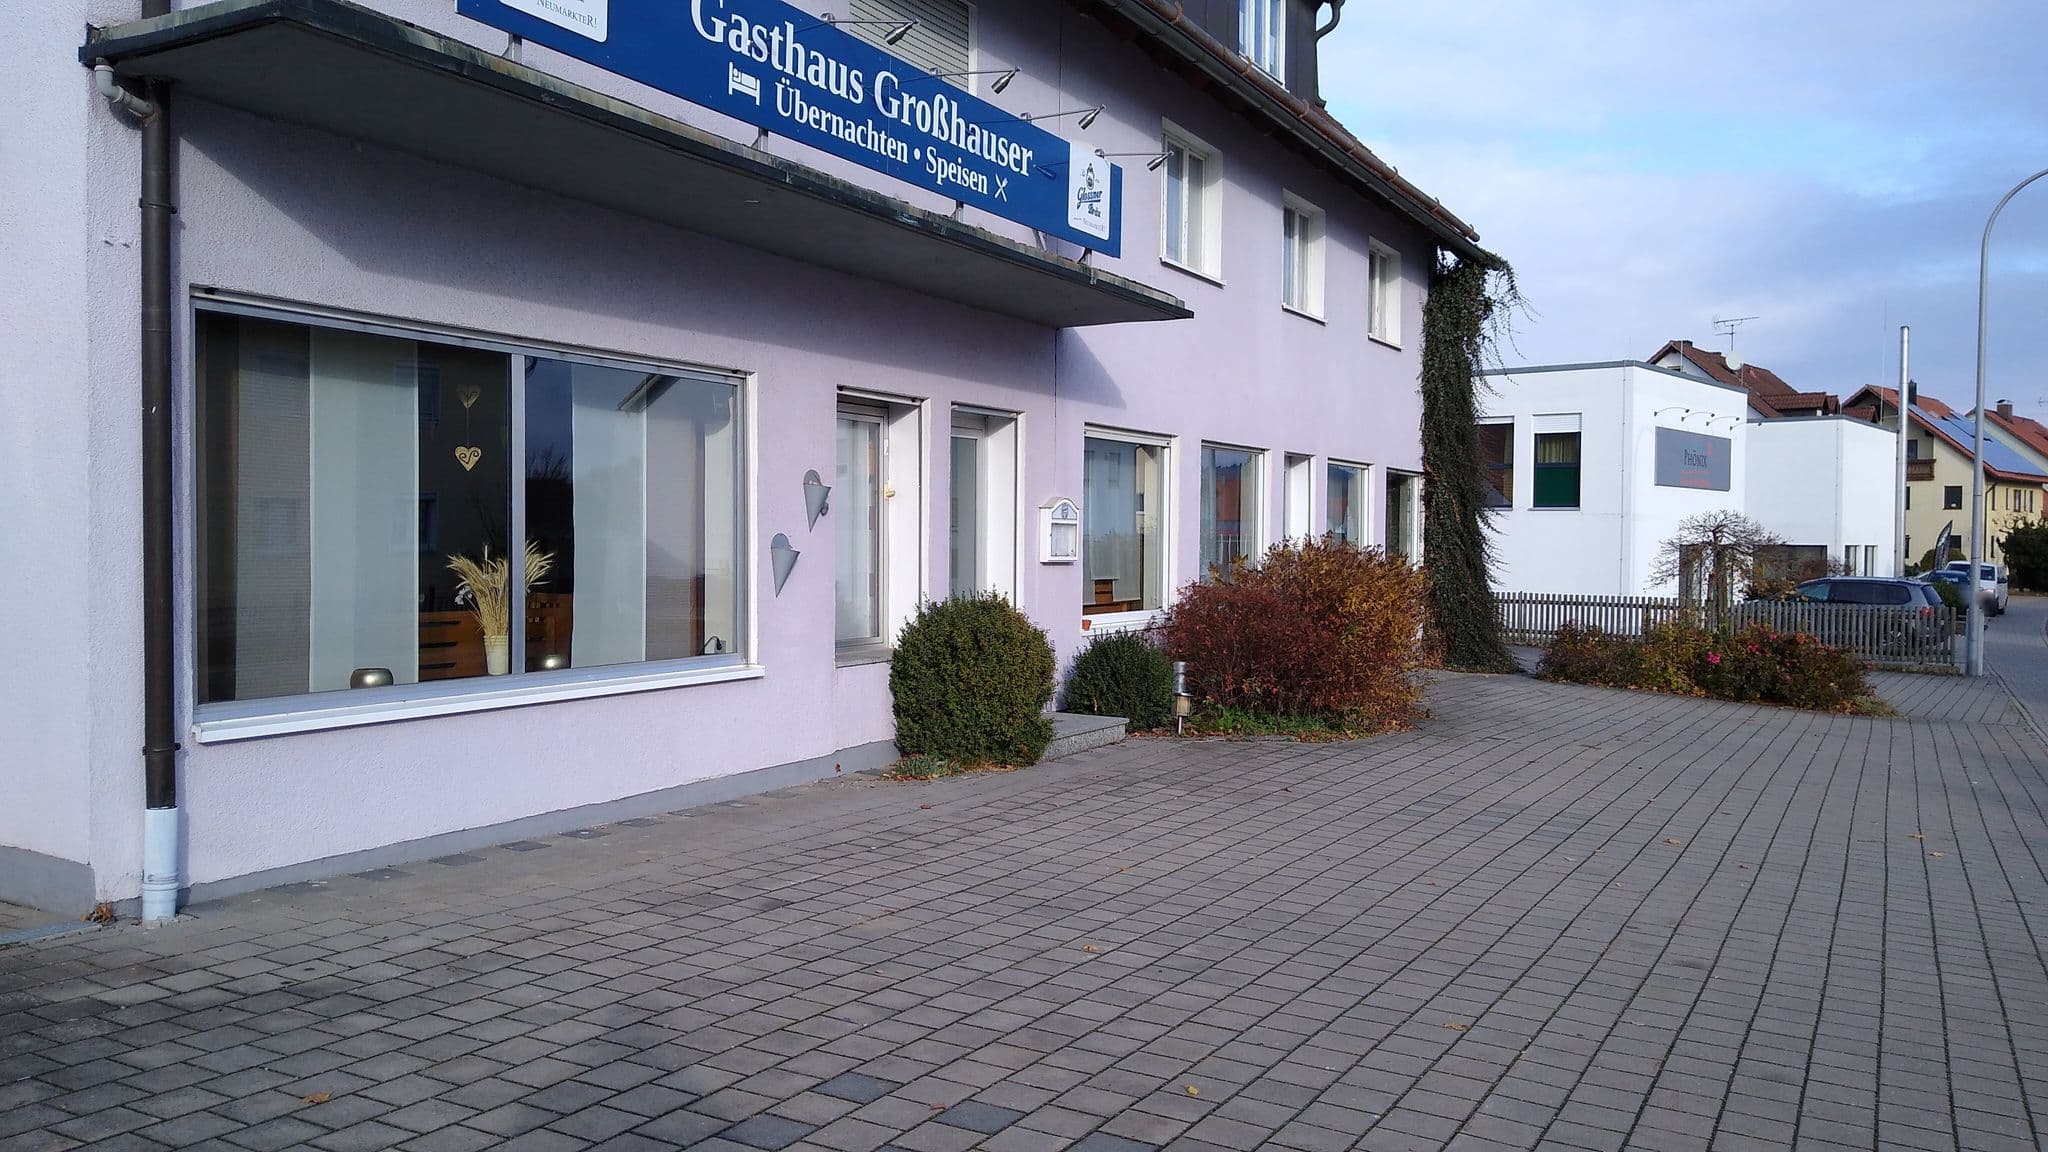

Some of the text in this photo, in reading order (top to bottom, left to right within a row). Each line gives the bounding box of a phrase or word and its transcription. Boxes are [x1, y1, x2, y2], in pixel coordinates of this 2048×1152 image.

[690, 0, 1033, 177] Gasthaus Großhauser
[775, 77, 988, 195] Übernachten Speisen
